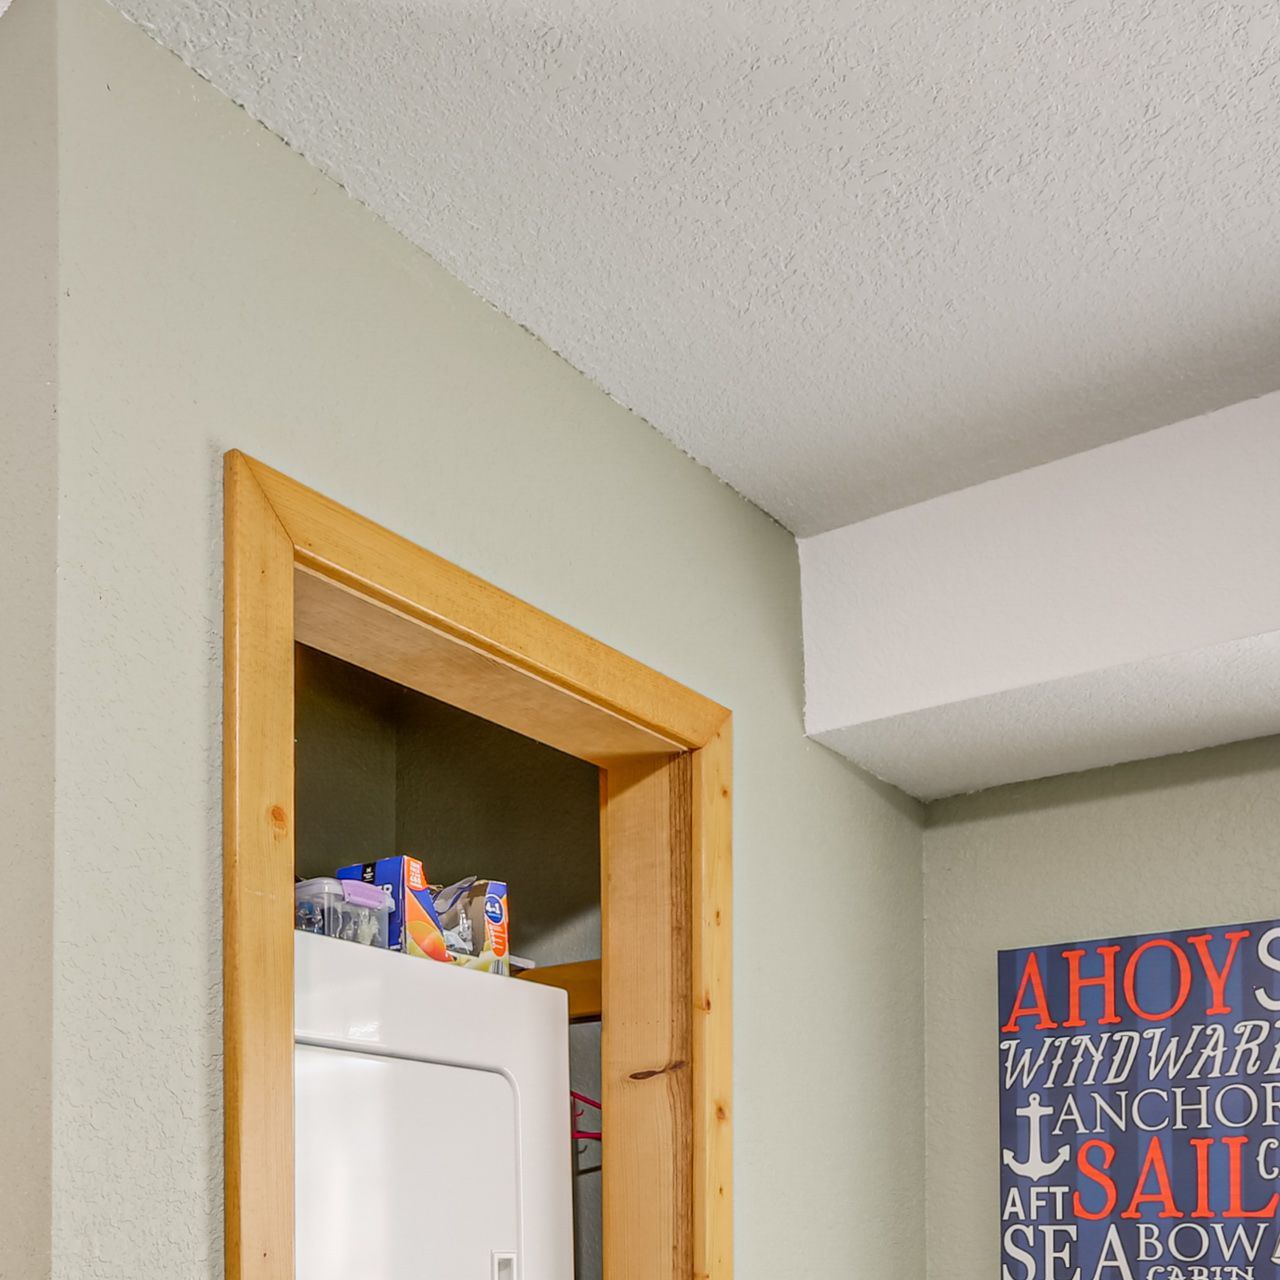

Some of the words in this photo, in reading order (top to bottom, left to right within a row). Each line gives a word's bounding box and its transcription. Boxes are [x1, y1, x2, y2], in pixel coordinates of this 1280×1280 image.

[1001, 930, 1252, 1032] AHOY
[1003, 1186, 1069, 1220] AFT
[1073, 1135, 1280, 1220] SAIL
[1137, 1222, 1270, 1262] BOW
